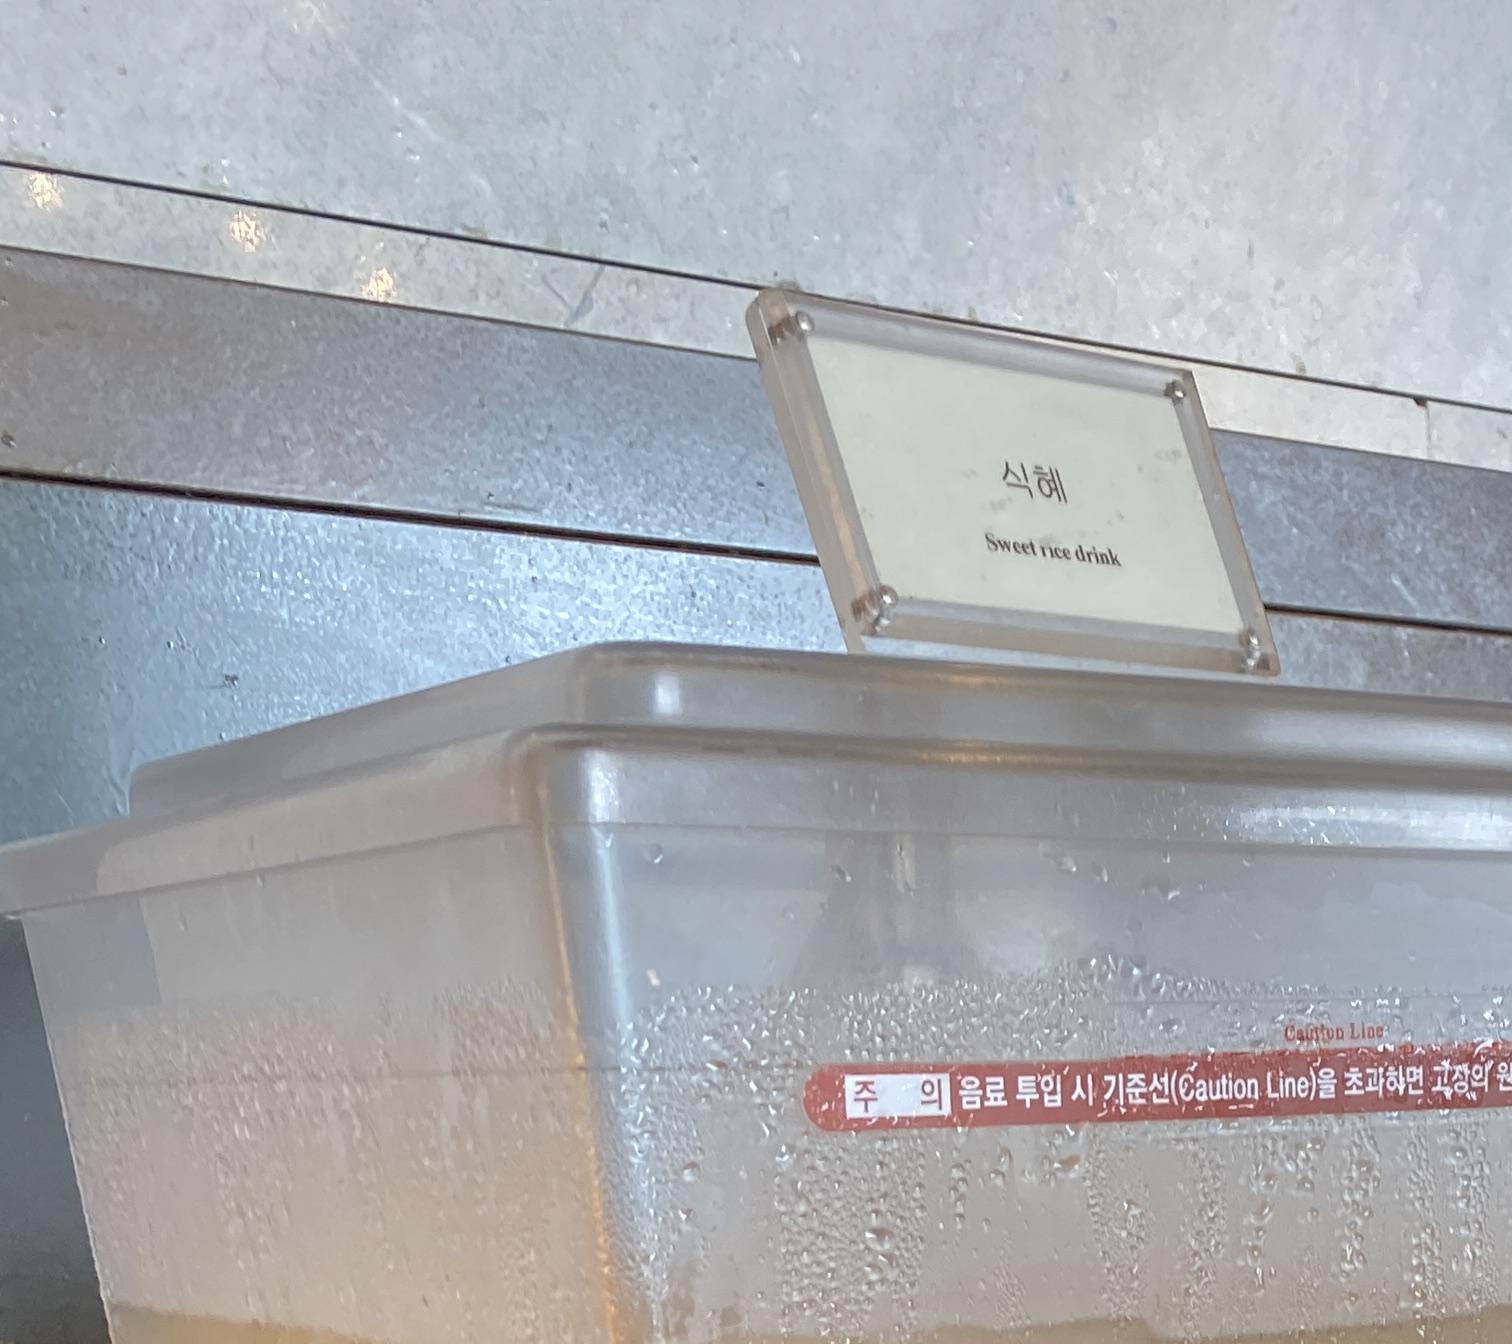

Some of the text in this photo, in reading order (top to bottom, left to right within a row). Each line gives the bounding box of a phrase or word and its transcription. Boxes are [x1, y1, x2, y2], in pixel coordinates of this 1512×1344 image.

[1001, 461, 1068, 503] 식혜
[984, 532, 1122, 568] Sweet rice drink
[1349, 1022, 1384, 1041] Line
[958, 1076, 1008, 1109] 음료
[1015, 1074, 1062, 1108] 투입
[1071, 1075, 1095, 1106] 시
[1345, 1063, 1424, 1097] 초과하면
[1433, 1060, 1490, 1096] 고장의
